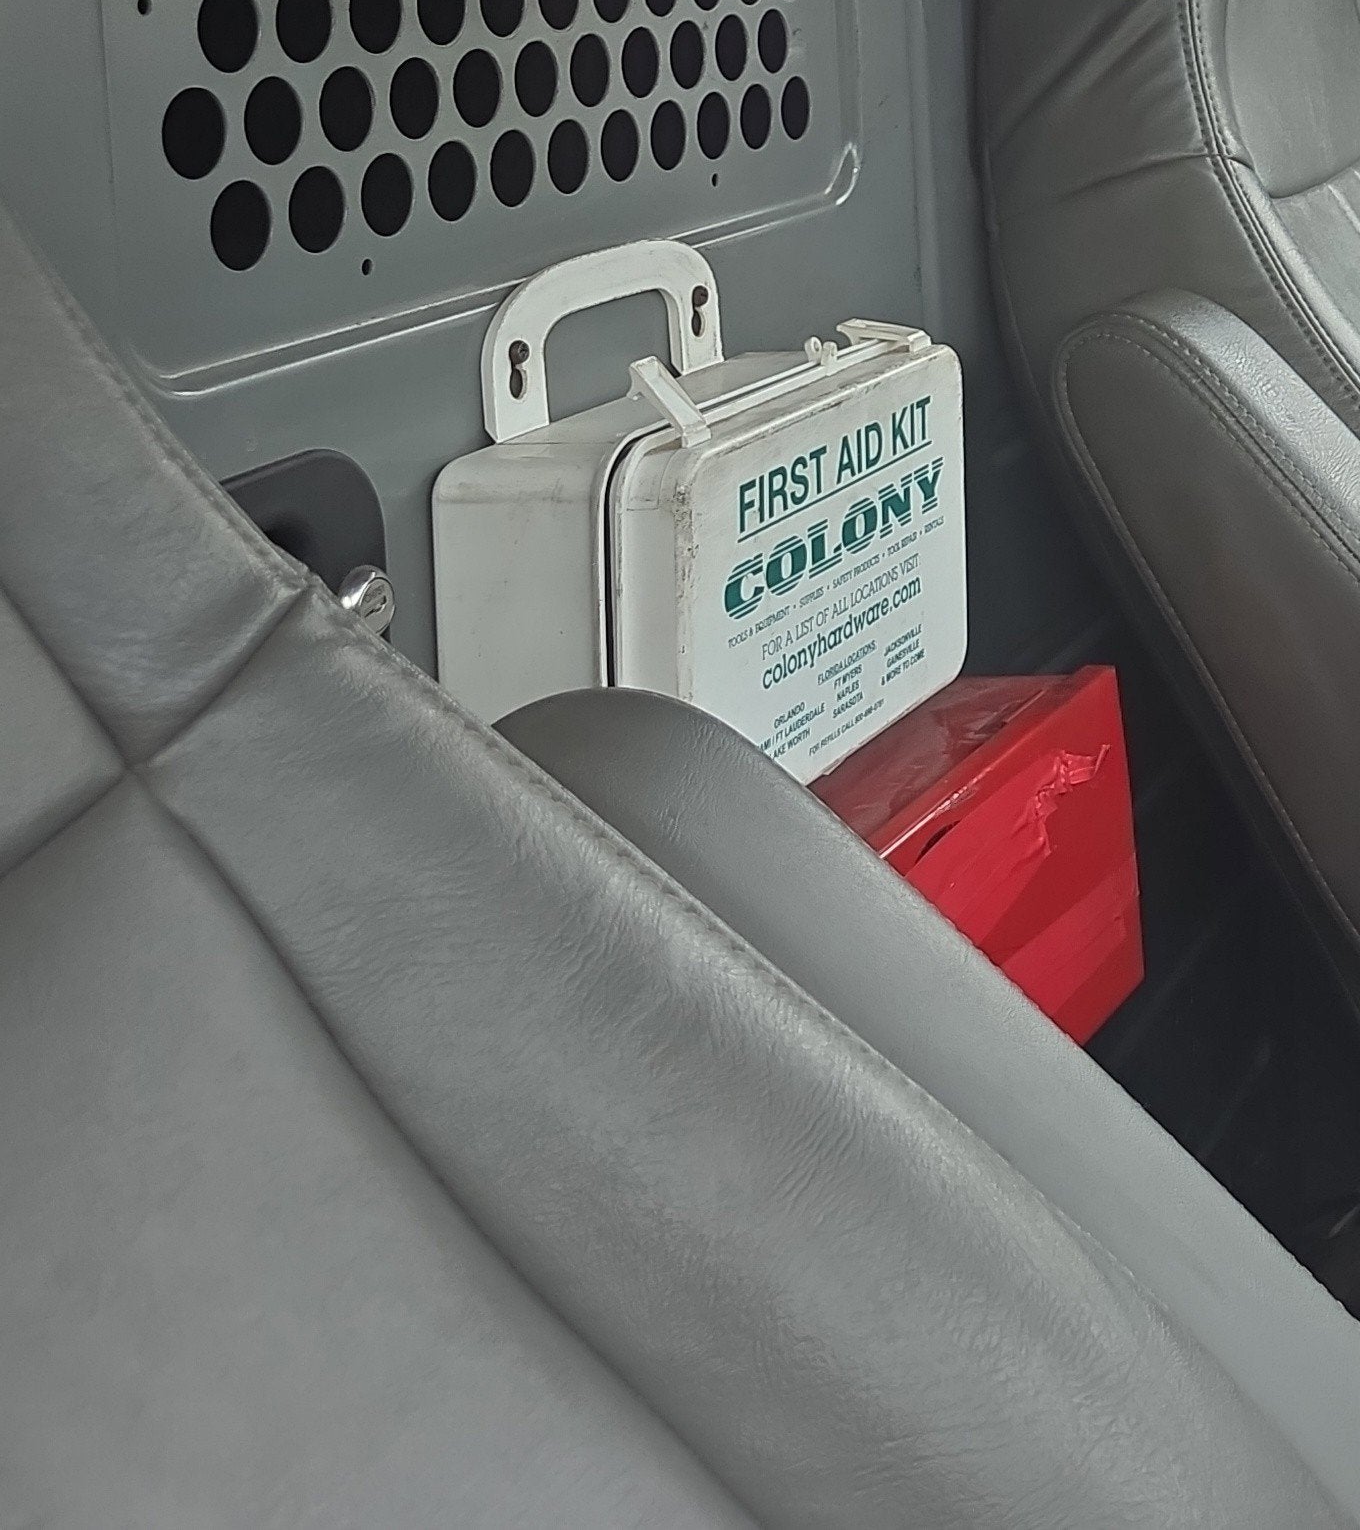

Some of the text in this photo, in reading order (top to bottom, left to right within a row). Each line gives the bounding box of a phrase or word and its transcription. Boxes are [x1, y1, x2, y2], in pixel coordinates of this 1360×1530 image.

[738, 395, 931, 535] FIRST AID KIT
[724, 456, 944, 620] COLONY
[762, 635, 783, 661] FOR
[785, 630, 794, 647] A
[795, 615, 815, 641] LIST
[816, 606, 830, 627] OF
[831, 596, 849, 620] ALL
[850, 565, 899, 608] LOCATIONS
[762, 576, 922, 690] colonyhardware.com
[773, 701, 806, 730] ORLANDO
[784, 701, 826, 738] LAUDERDALE
[832, 690, 864, 719] SARASOTA
[836, 679, 860, 702] NAPLES
